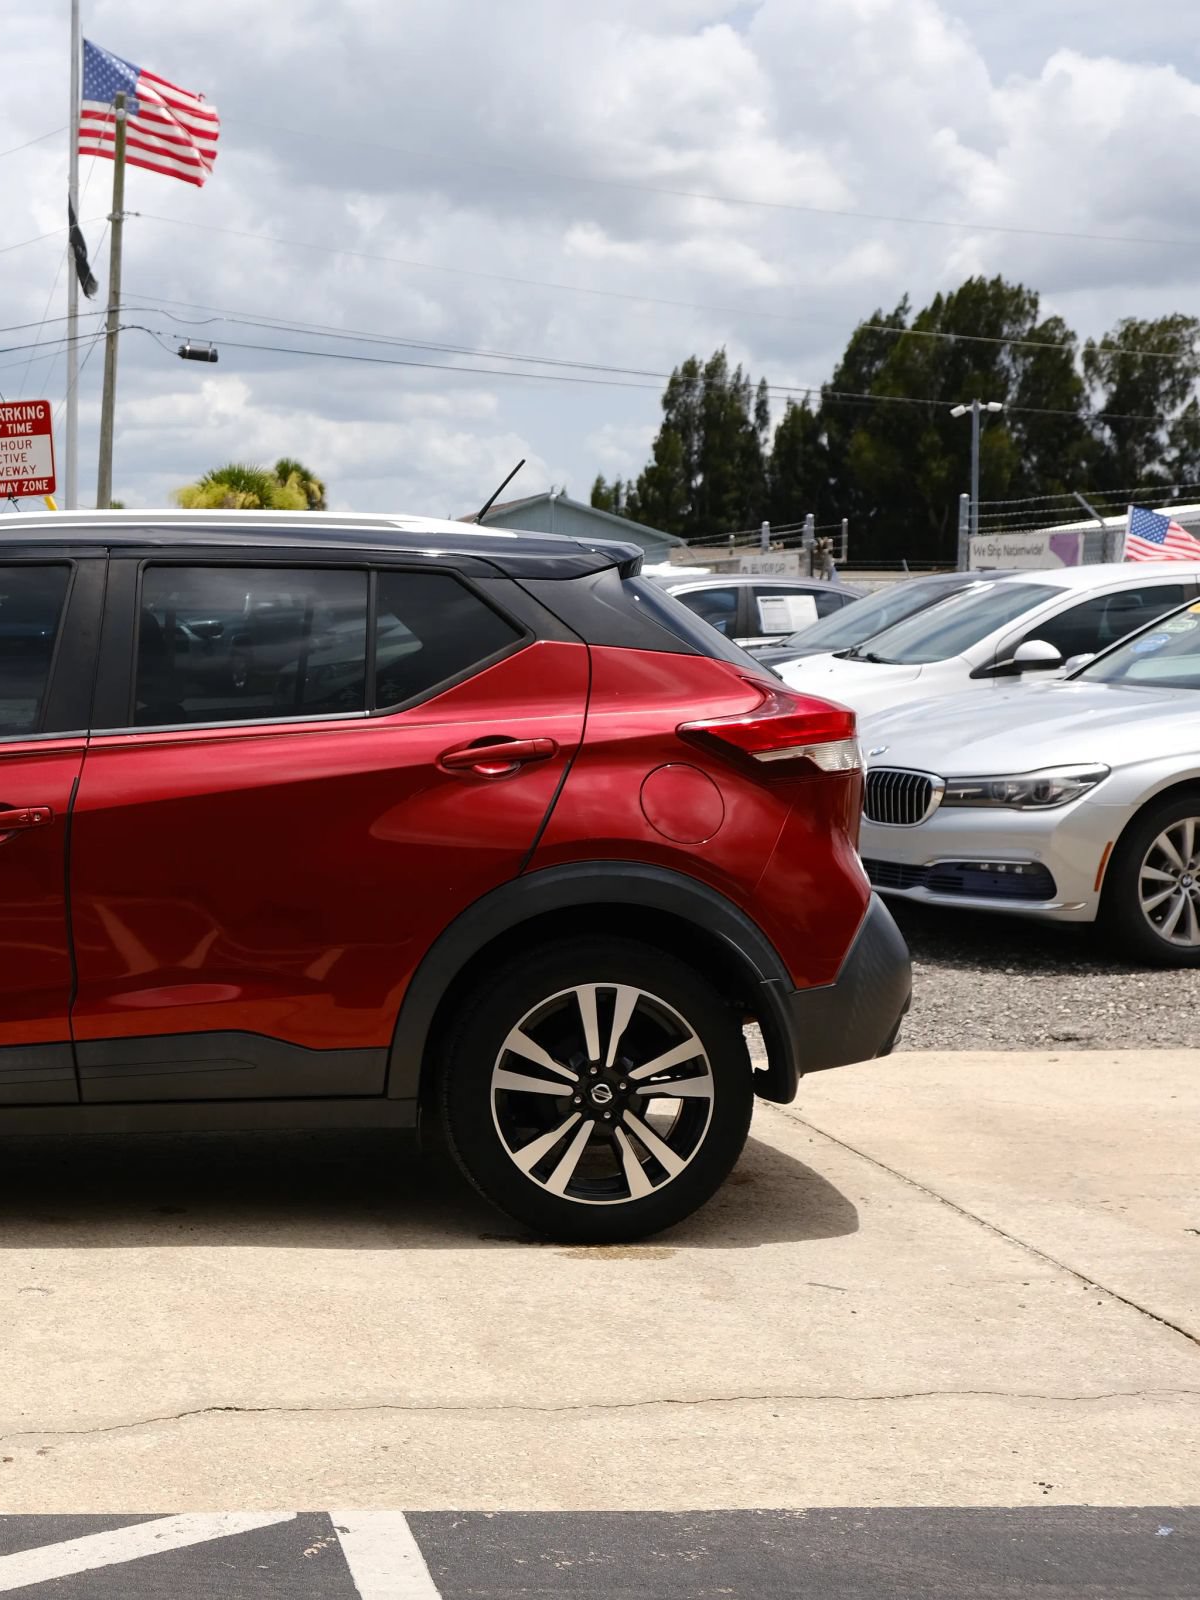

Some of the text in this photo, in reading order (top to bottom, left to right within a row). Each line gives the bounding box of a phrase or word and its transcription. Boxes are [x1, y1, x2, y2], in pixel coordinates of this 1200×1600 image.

[6, 422, 34, 435] TIME
[0, 440, 32, 451] HOUR
[22, 479, 49, 492] ZONE
